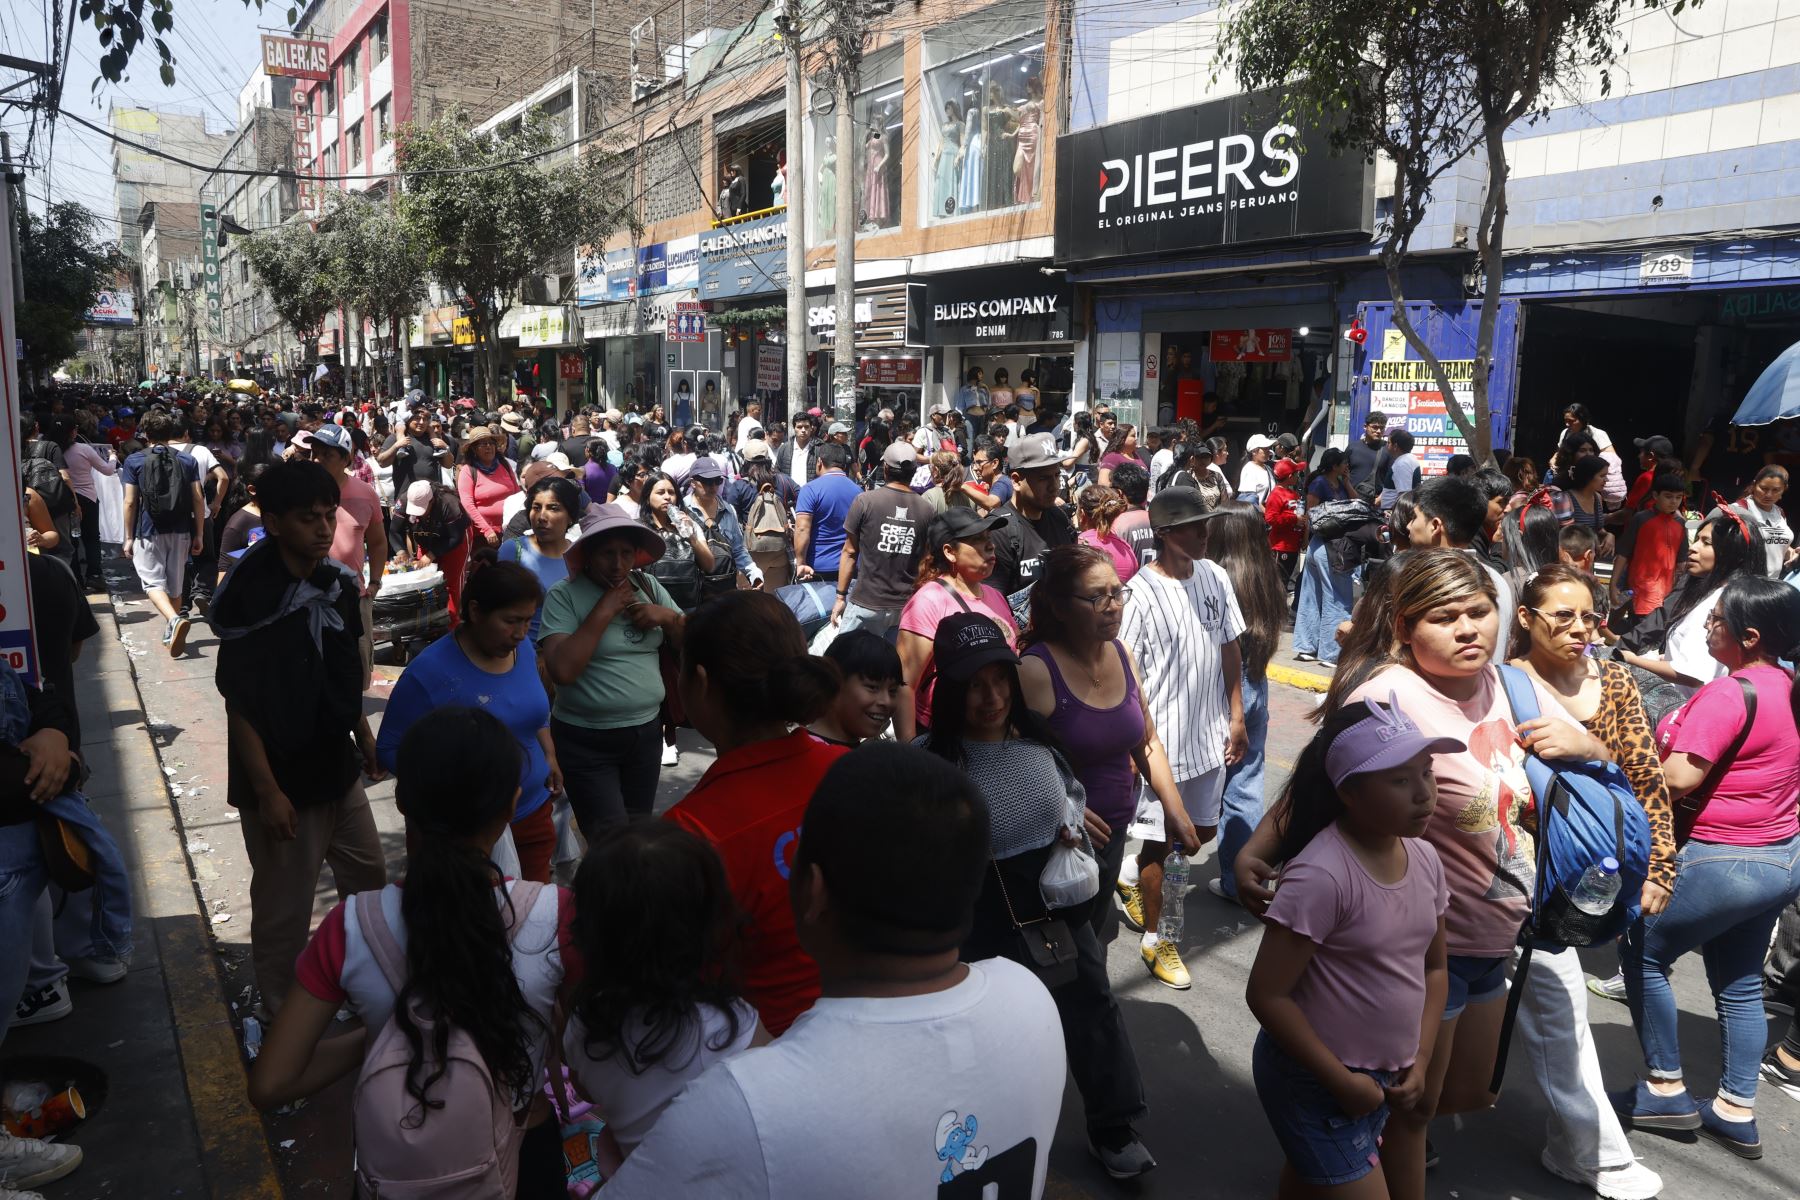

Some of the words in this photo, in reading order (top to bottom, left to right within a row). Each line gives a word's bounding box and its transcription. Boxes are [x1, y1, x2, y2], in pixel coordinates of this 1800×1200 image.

[1099, 123, 1299, 213] PIEERS
[1099, 219, 1111, 229] EL
[1116, 209, 1175, 226] ORIGINAL
[1180, 201, 1223, 217] JEANS
[1230, 190, 1298, 210] PERUANO
[1649, 258, 1681, 274] 789
[934, 302, 977, 321] BLUES
[979, 294, 1058, 318] COMPANY
[976, 325, 1006, 337] DENIM
[1052, 331, 1063, 339] 785
[1374, 361, 1411, 380] AGENTE
[1374, 382, 1417, 391] RETIROS
[1418, 382, 1425, 391] Y
[1408, 418, 1444, 432] BBVA
[1428, 438, 1437, 446] DE
[880, 523, 916, 537] CREA
[880, 532, 914, 546] TORS
[1766, 535, 1789, 545] adidas
[877, 541, 912, 555] CLUB
